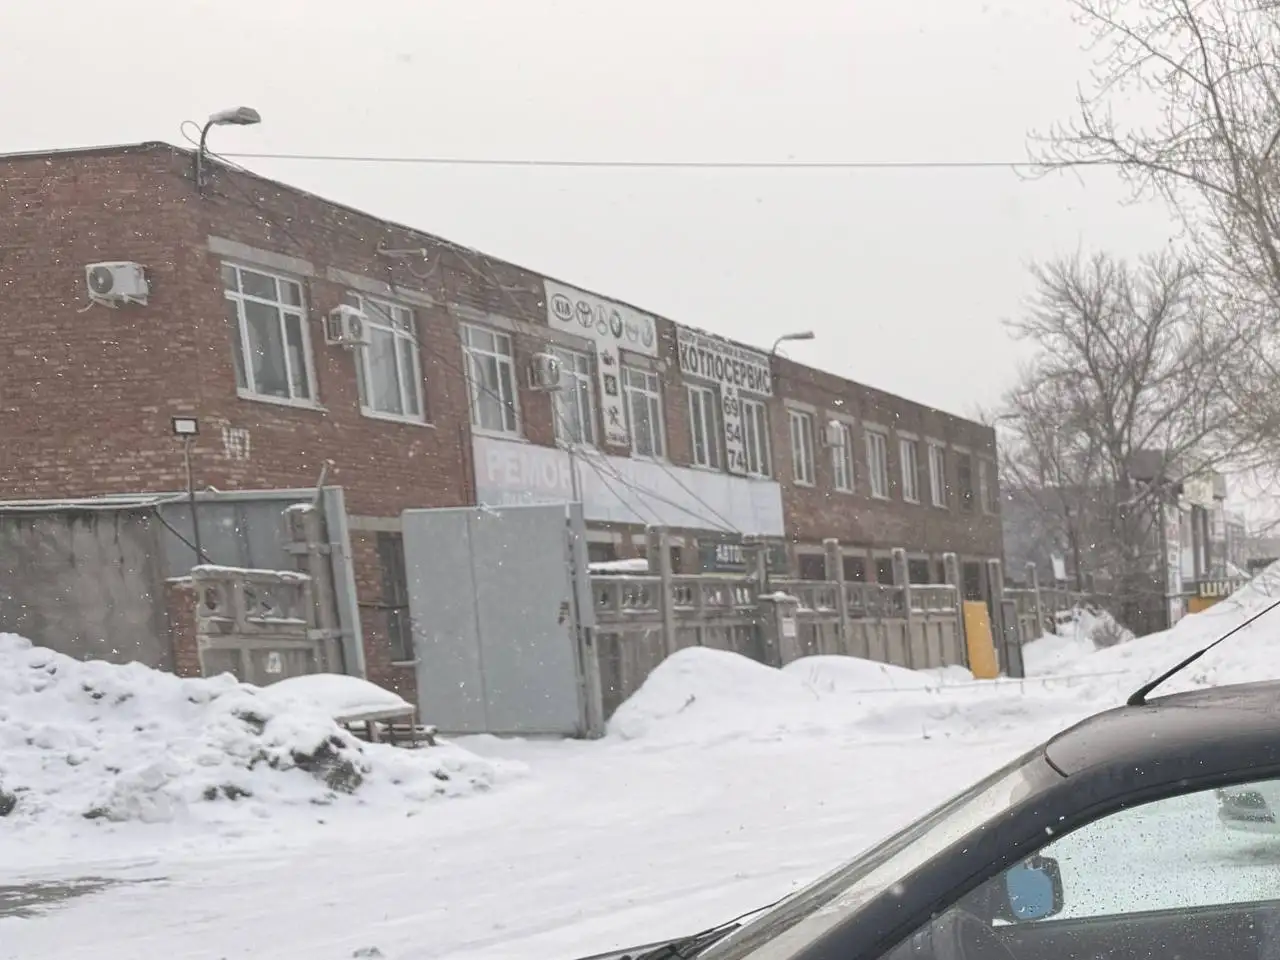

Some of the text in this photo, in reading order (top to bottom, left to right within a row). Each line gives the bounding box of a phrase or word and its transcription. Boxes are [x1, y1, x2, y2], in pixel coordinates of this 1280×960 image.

[553, 297, 573, 318] KIA
[726, 423, 742, 443] 54
[728, 449, 746, 469] 74
